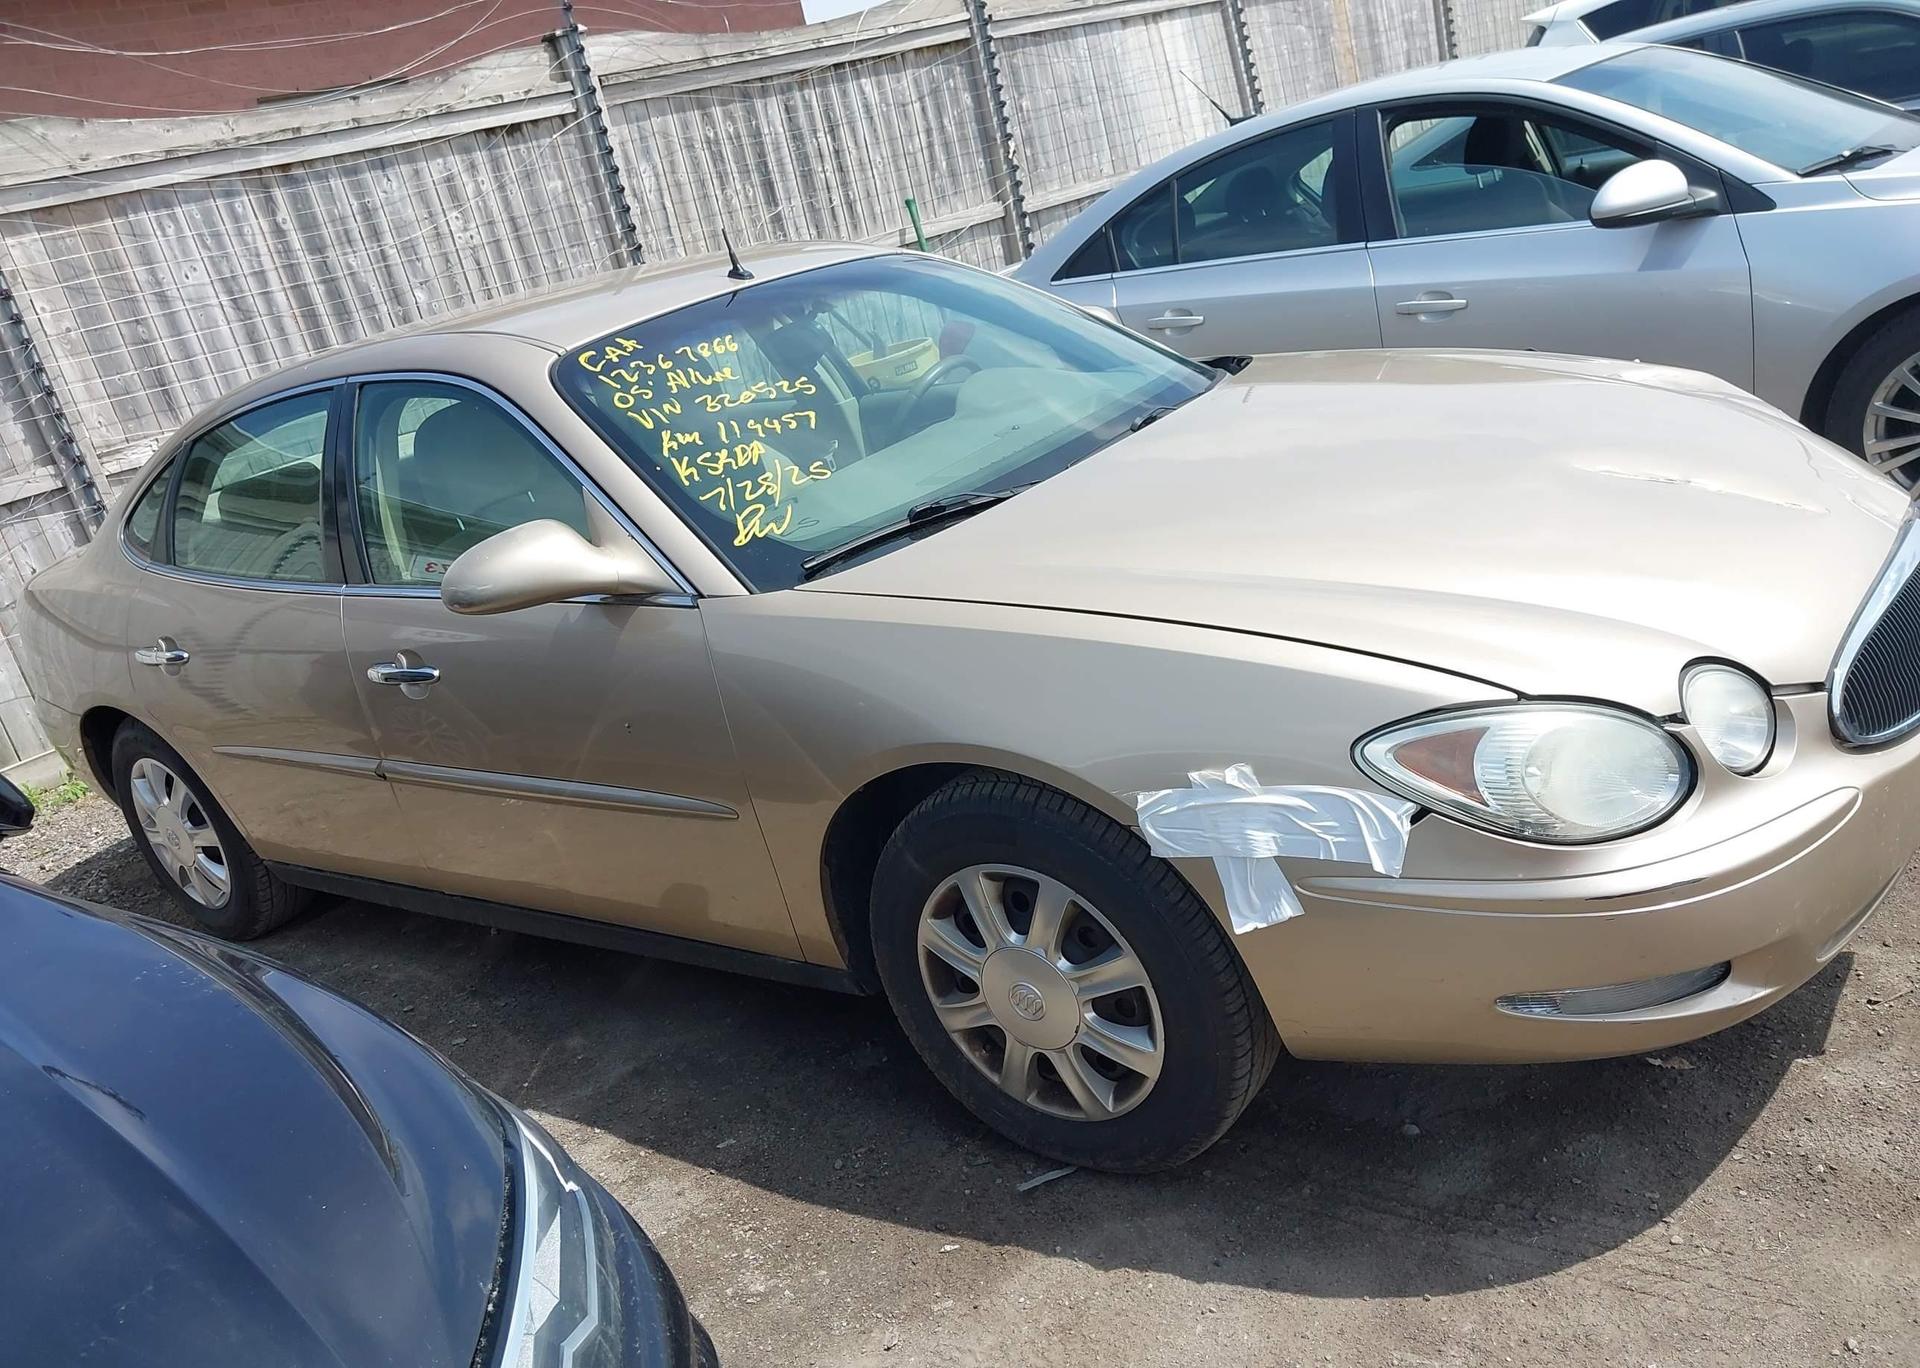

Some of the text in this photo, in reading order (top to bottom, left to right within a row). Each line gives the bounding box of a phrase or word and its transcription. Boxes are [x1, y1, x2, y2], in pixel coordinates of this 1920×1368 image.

[578, 337, 644, 372] CAA
[626, 376, 816, 429] VIN 320525
[717, 410, 816, 444] 119457
